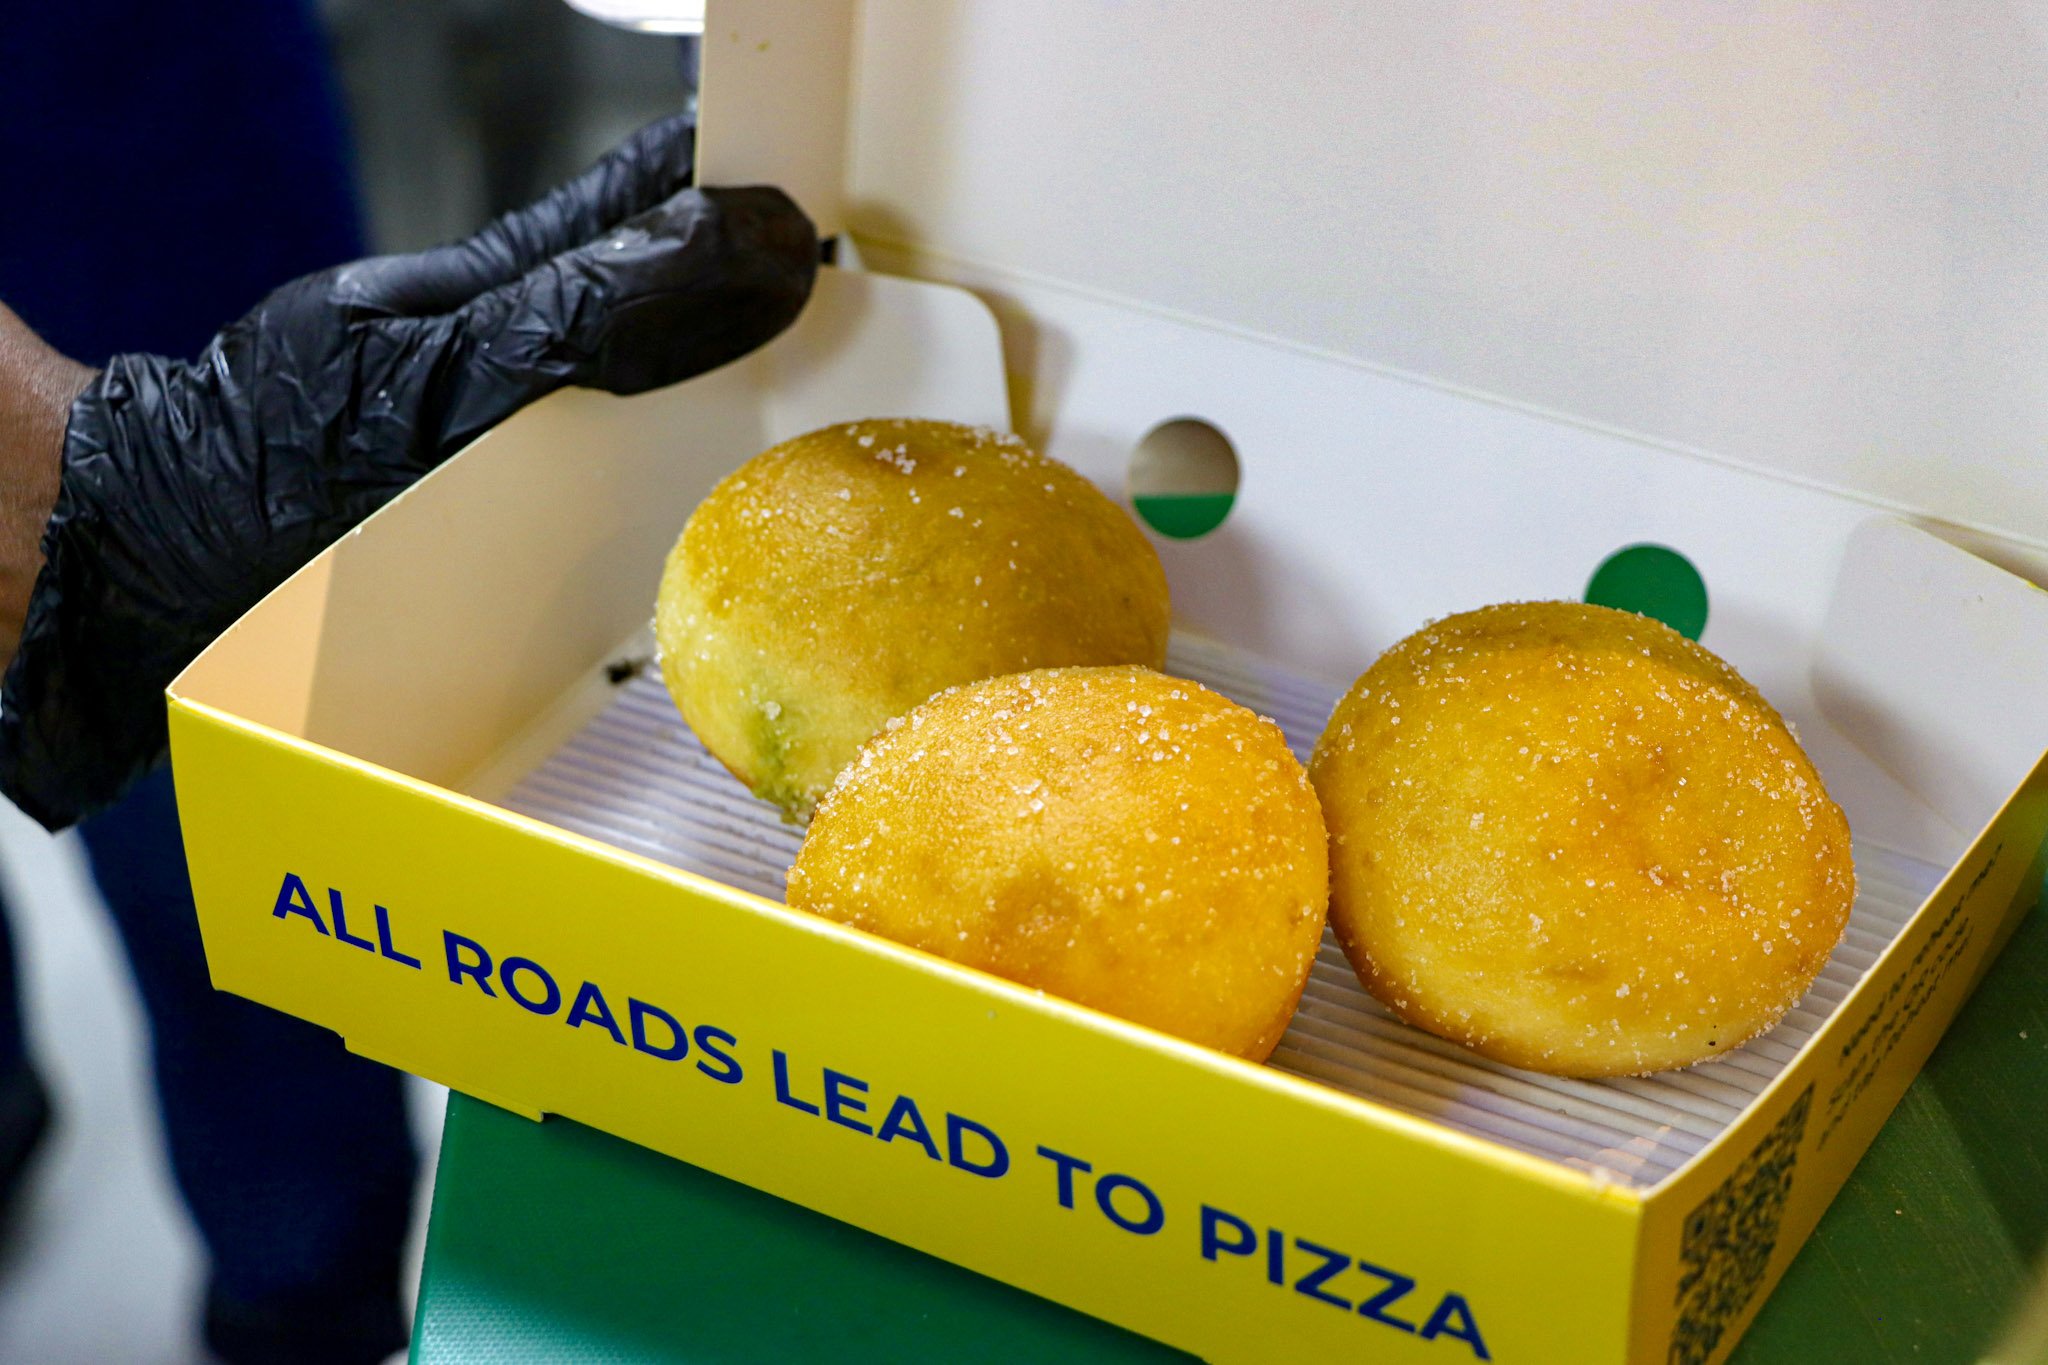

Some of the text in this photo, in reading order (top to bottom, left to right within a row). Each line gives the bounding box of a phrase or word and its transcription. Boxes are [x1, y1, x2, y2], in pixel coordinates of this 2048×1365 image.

[272, 872, 1491, 1361] ALL ROADS LEAD TO PIZZA
